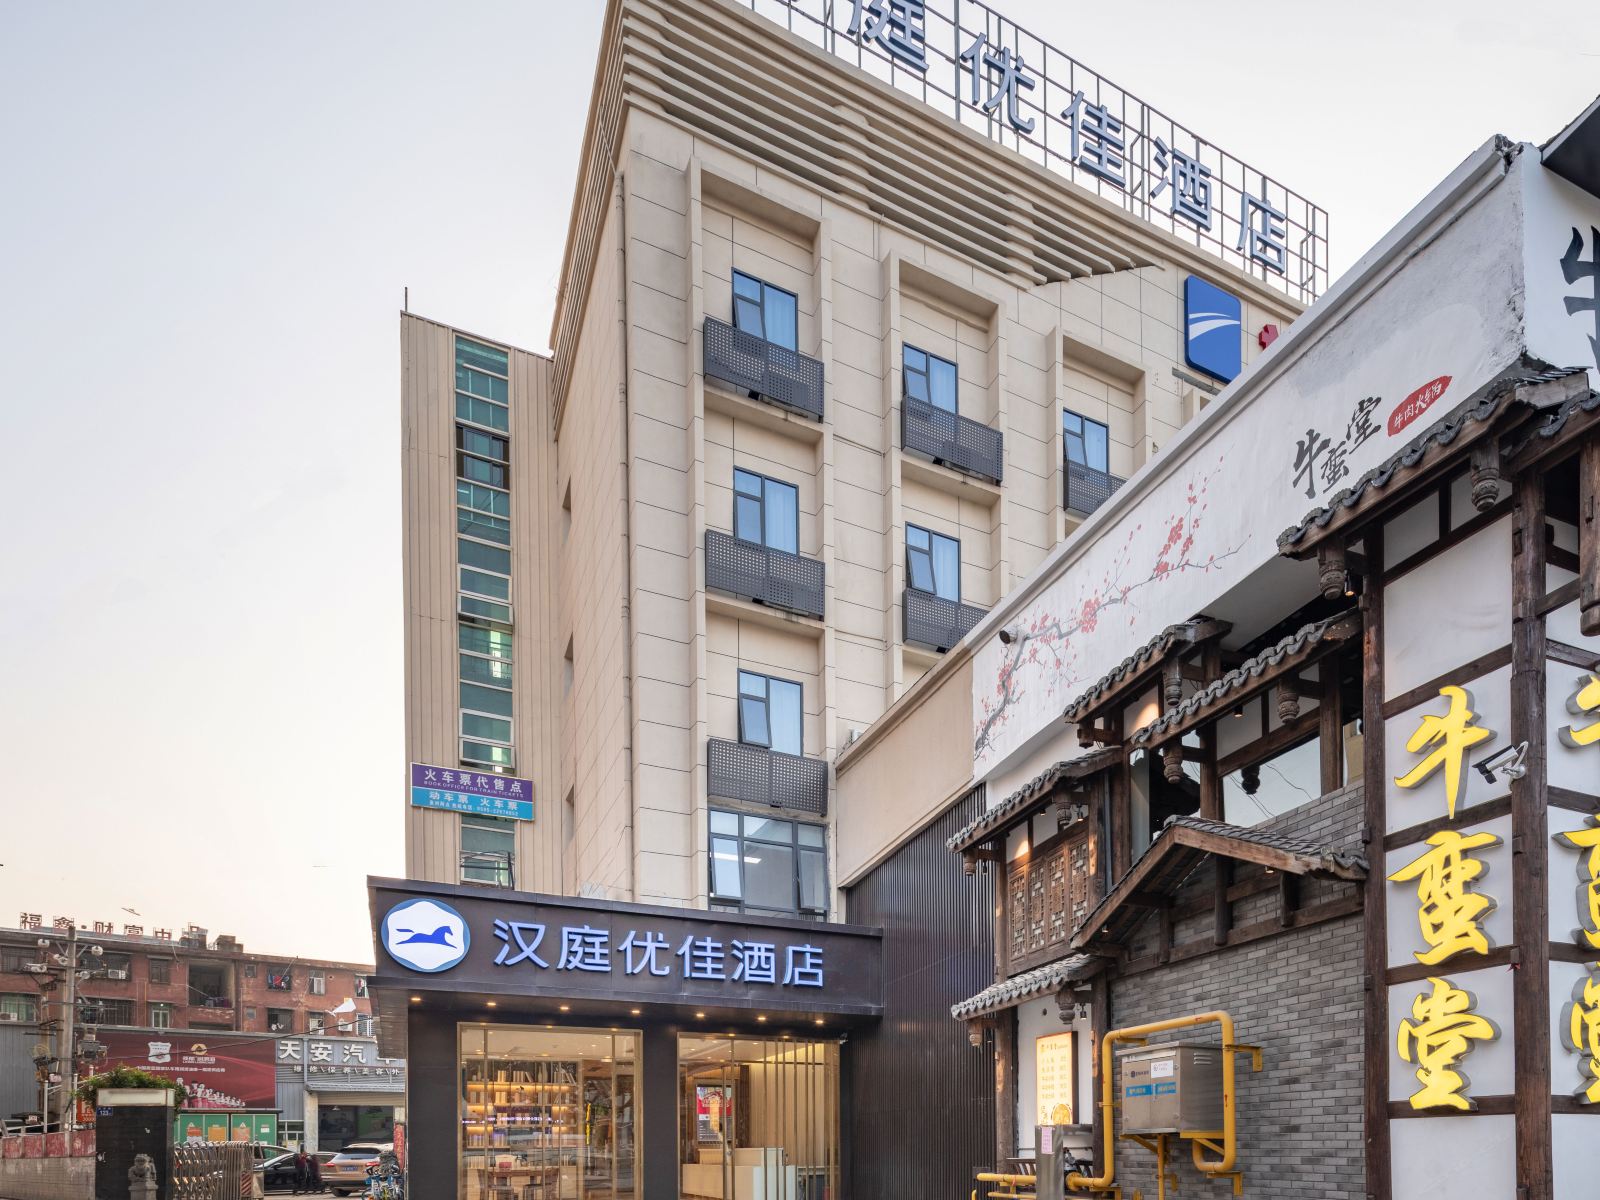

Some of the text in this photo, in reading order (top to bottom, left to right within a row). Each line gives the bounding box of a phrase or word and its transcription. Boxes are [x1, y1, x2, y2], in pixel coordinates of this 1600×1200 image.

[424, 768, 522, 793] 火车票代售点
[429, 790, 518, 811] 动车票 火车票
[493, 917, 825, 988] 汉庭优佳酒店
